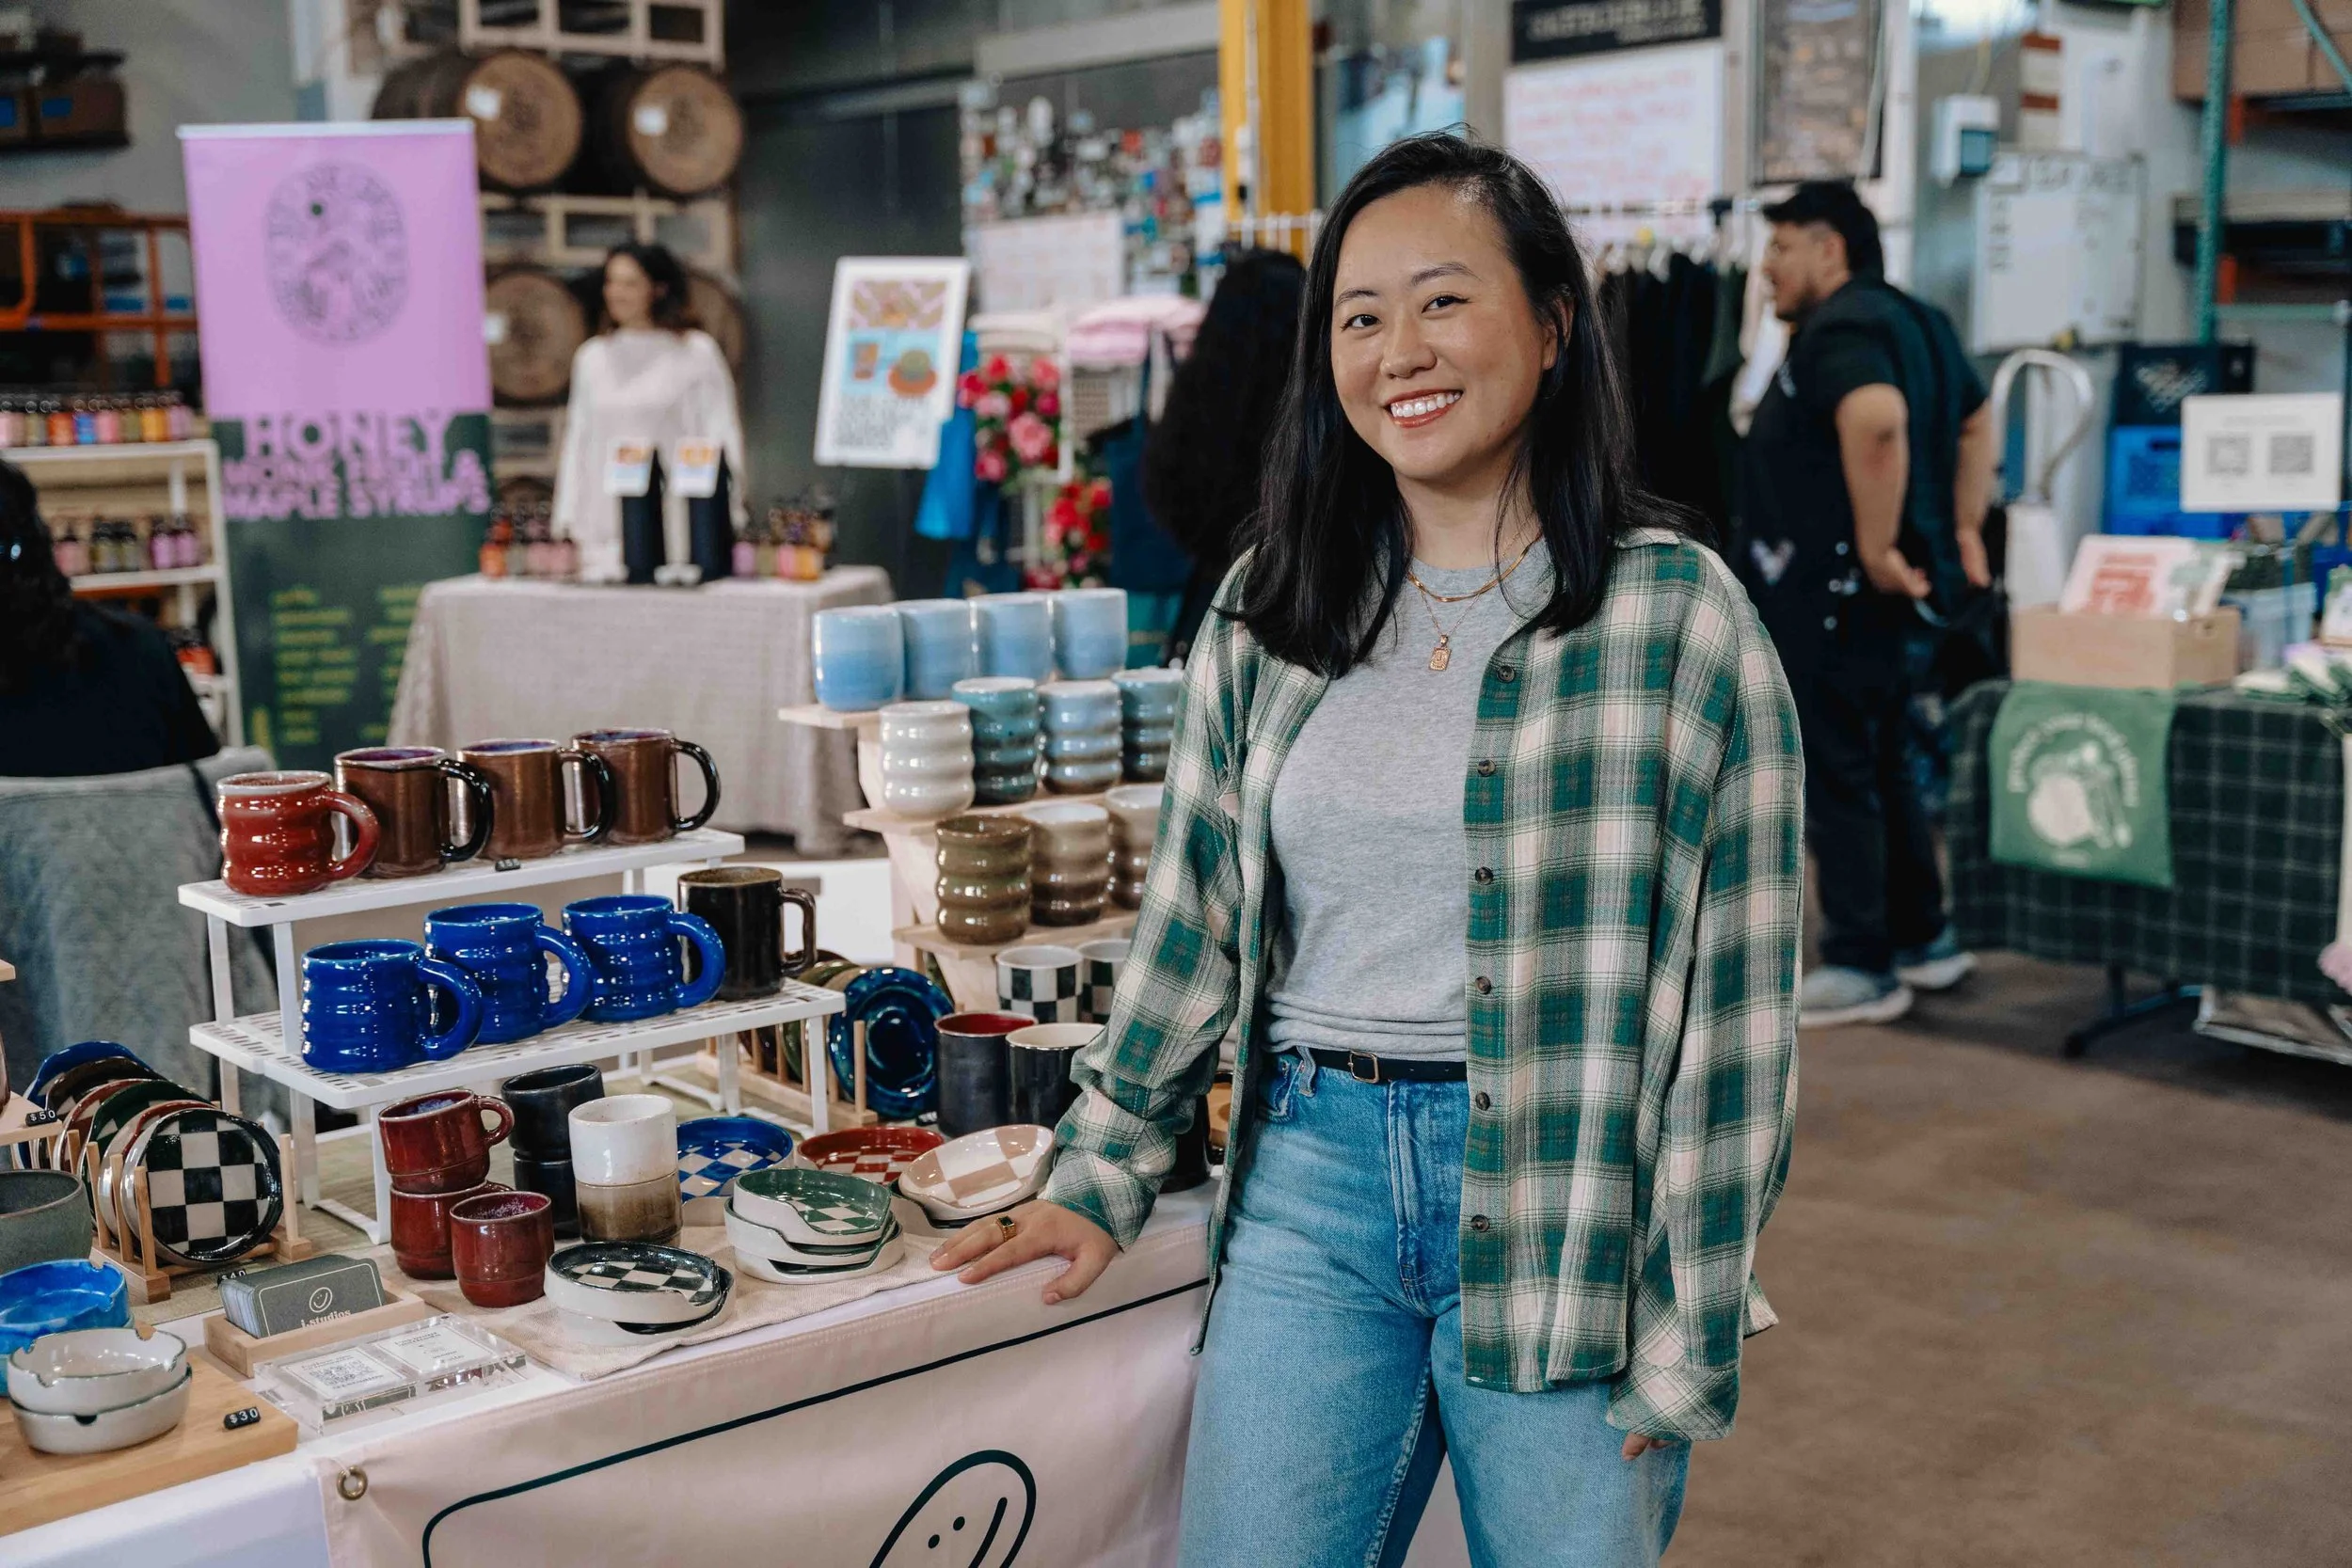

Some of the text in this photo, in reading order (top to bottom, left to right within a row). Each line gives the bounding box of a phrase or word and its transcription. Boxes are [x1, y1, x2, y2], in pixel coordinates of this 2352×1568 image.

[244, 410, 451, 459] HONEY
[222, 482, 490, 518] MAPLE SYRUPS
[29, 1110, 56, 1122] $50
[229, 1408, 258, 1424] $30
